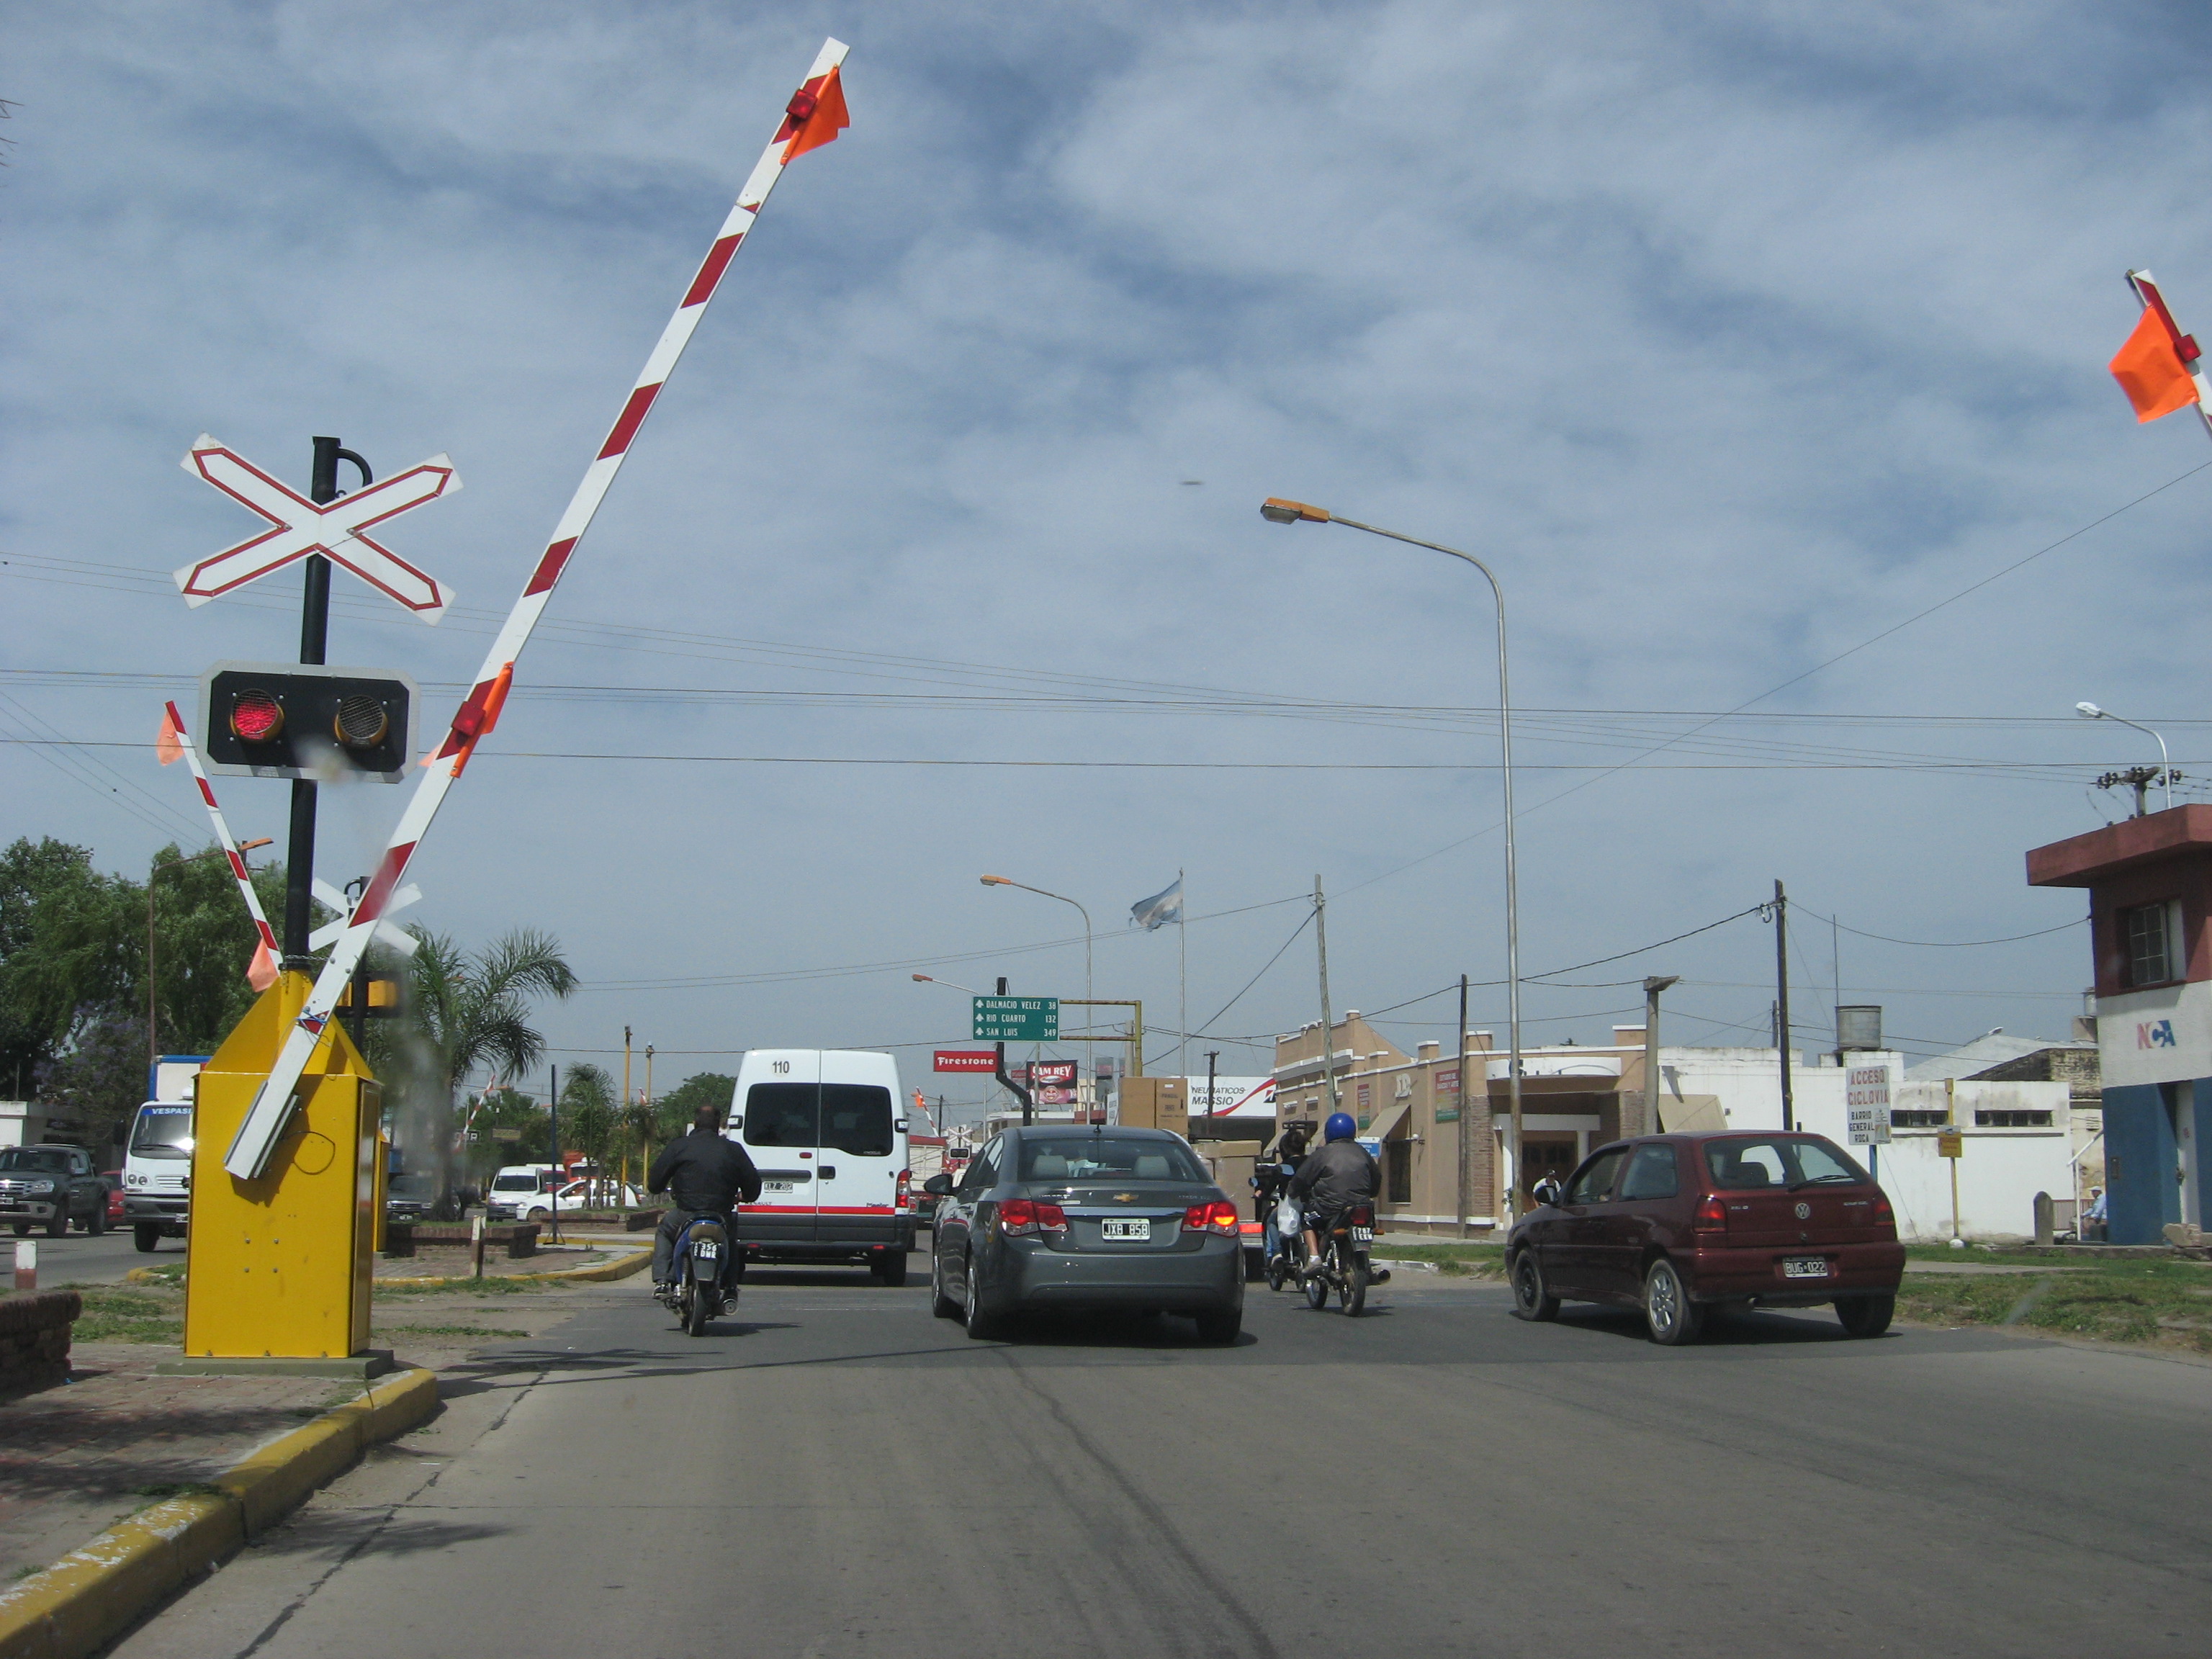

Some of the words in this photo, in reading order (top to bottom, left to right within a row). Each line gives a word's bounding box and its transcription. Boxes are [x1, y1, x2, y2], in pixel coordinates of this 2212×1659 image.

[986, 1000, 1017, 1009] DALMACIO
[986, 1014, 997, 1022] RIO
[1001, 1014, 1026, 1022] CUARTO
[1045, 1015, 1056, 1023] 132
[986, 1028, 999, 1036] SAN
[1003, 1028, 1018, 1036] LUIS
[1043, 1028, 1056, 1037] 349
[937, 1056, 994, 1066] Firestone
[773, 1061, 790, 1074] 110
[1053, 1065, 1071, 1077] REY
[1851, 1069, 1884, 1085] ACCESO
[1848, 1089, 1889, 1105] CICLOVIA
[1852, 1111, 1871, 1120] BARRIO
[1849, 1123, 1874, 1131] GENERAL
[1105, 1223, 1123, 1236] JXB
[1128, 1223, 1148, 1236] 858
[701, 1243, 717, 1251] 356
